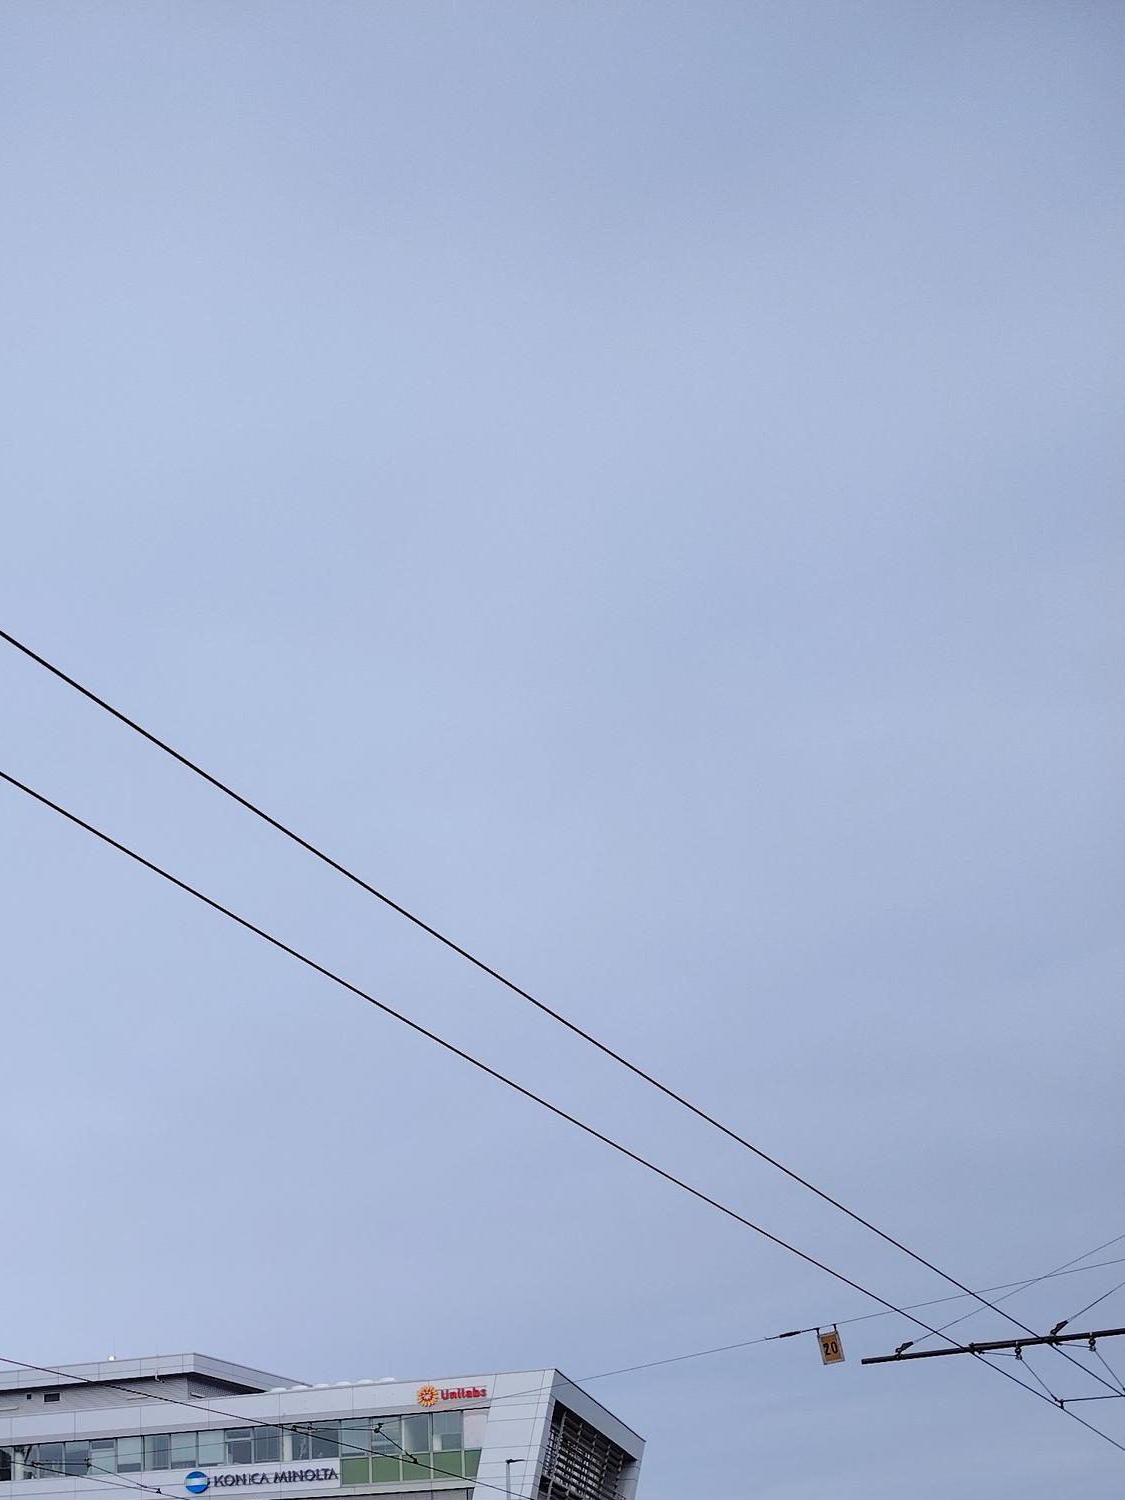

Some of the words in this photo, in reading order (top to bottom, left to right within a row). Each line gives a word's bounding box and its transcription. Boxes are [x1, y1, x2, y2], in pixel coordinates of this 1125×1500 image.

[823, 1342, 838, 1355] 20
[440, 1387, 487, 1400] Unilabs
[213, 1472, 269, 1487] KONICA
[273, 1468, 339, 1483] MINOLTA
